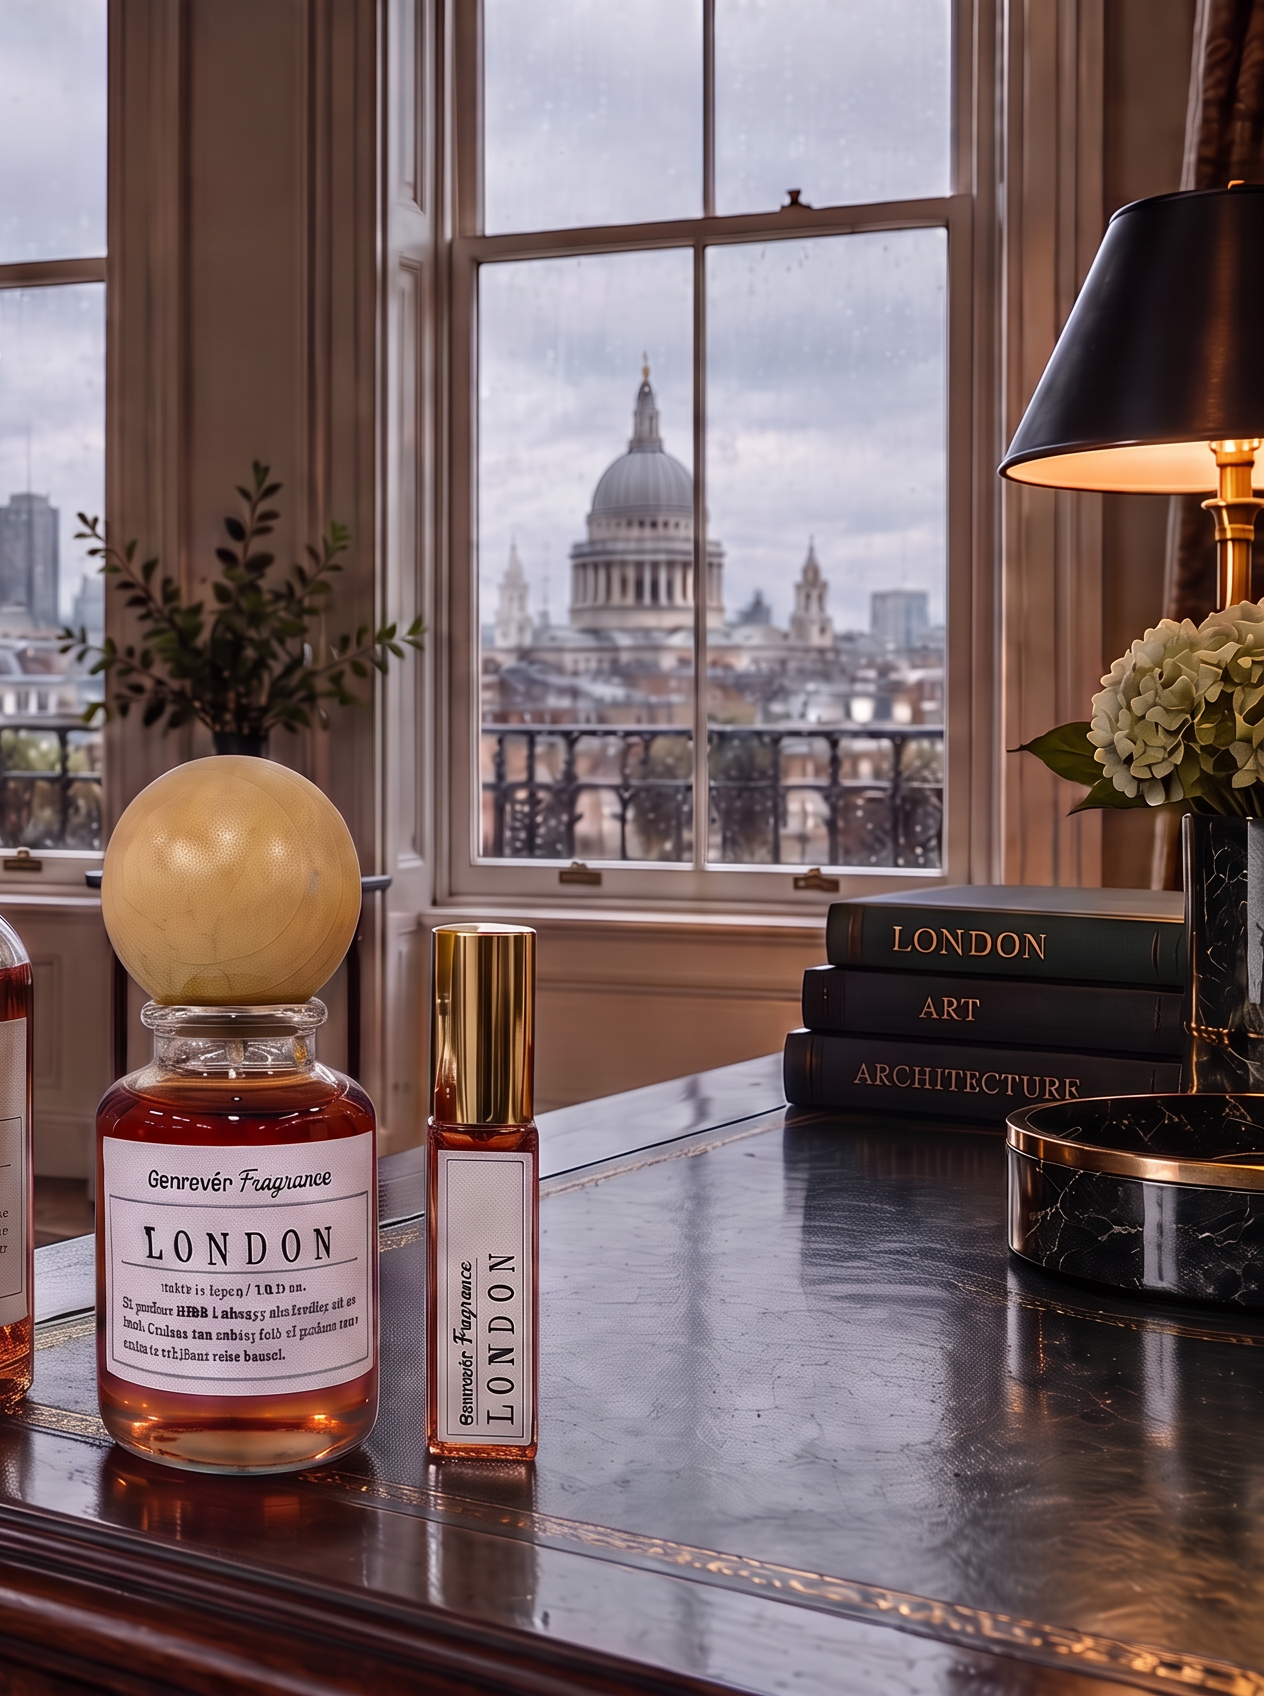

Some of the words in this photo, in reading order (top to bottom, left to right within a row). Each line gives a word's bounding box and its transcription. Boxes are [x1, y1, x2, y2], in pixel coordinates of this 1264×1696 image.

[892, 926, 1046, 960] LONDON
[918, 996, 981, 1022] ART
[148, 1169, 233, 1192] Genrevér
[238, 1168, 332, 1198] Fragrance
[143, 1226, 332, 1266] LONDON
[486, 1253, 515, 1425] LONDON
[212, 1350, 241, 1362] reise
